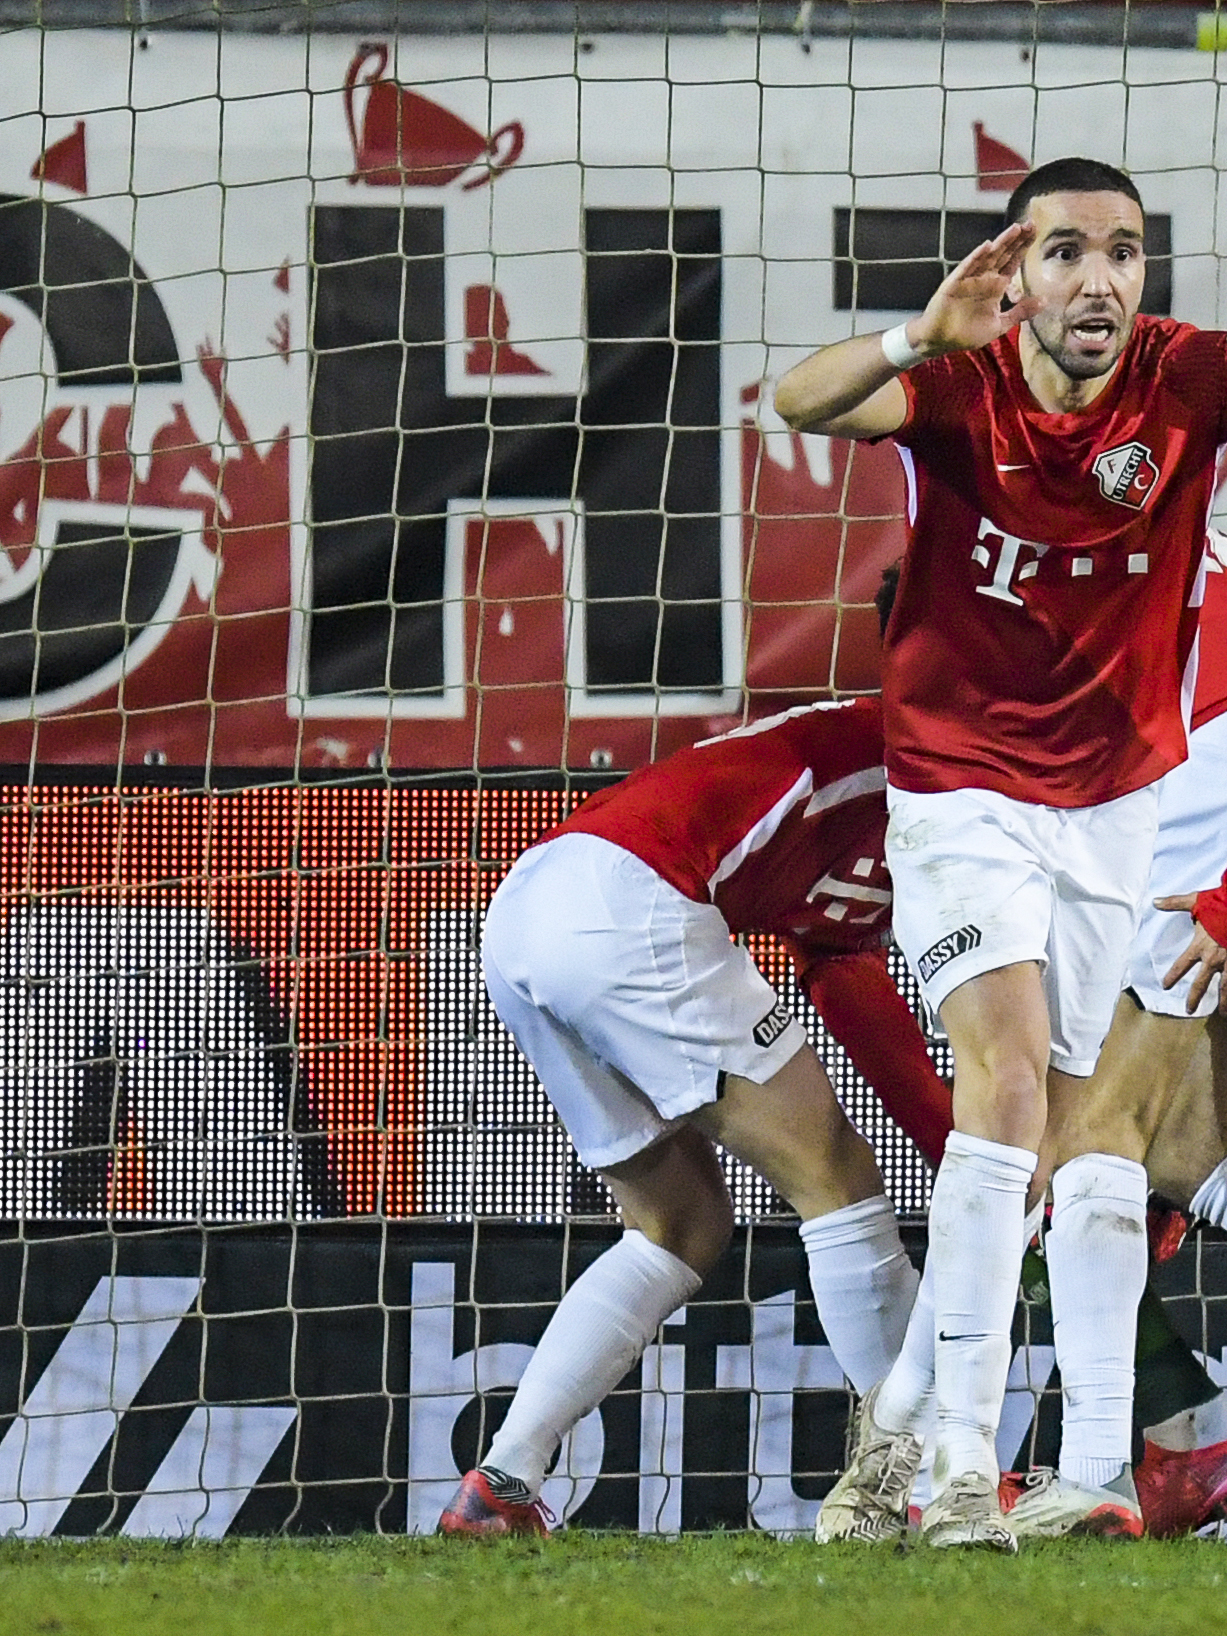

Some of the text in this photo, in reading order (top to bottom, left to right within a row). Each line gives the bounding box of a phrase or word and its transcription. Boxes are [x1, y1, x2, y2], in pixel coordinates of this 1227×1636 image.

[1112, 448, 1144, 500] UTRECHT
[1134, 474, 1149, 490] C
[919, 933, 960, 981] DASSY
[756, 1003, 791, 1044] DAS
